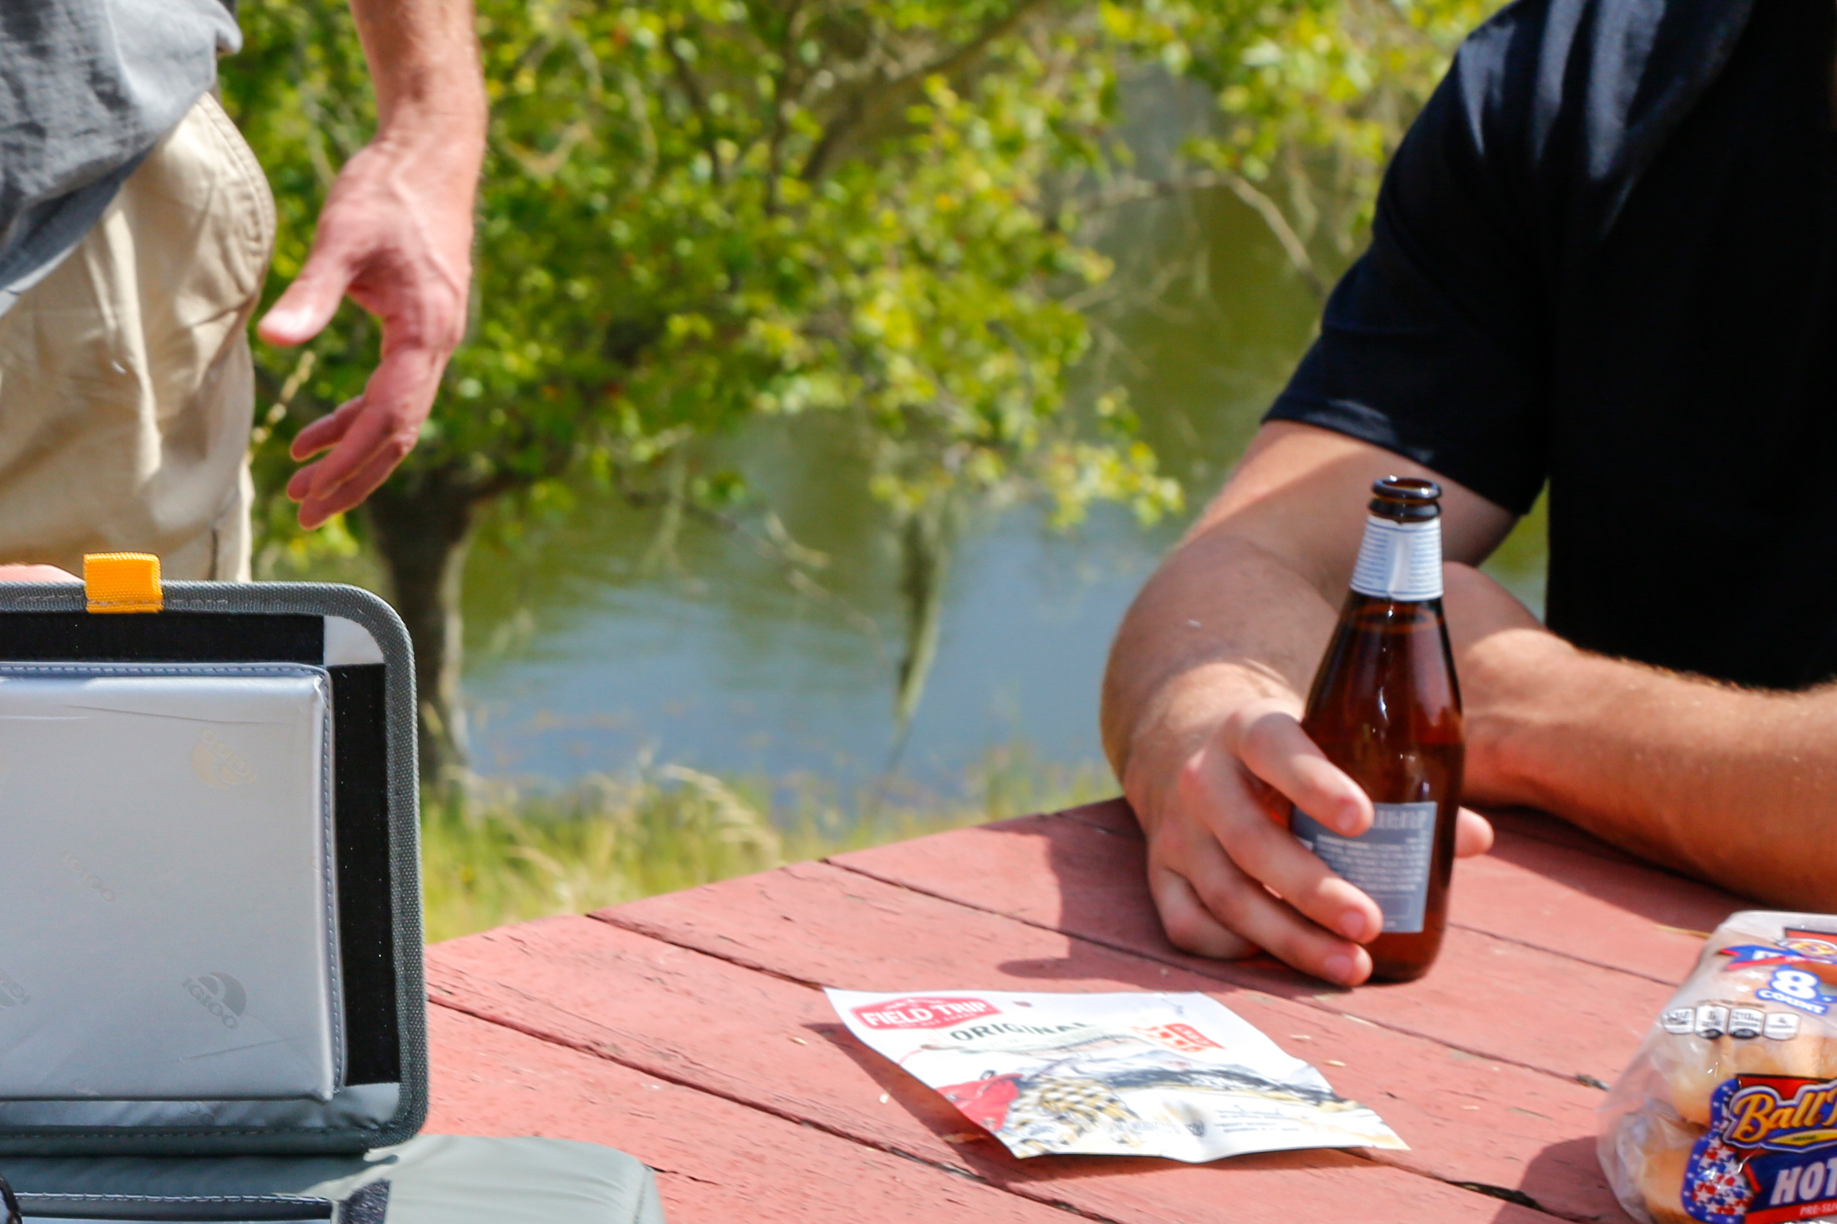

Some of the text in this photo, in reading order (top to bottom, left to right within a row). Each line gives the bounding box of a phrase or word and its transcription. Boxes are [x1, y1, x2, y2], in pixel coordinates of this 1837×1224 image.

[1771, 969, 1818, 999] 8
[181, 976, 238, 1031] IGLOO
[861, 1008, 934, 1026] FIELD
[929, 1001, 988, 1016] TRIP
[950, 1021, 1090, 1042] ORIGINAL
